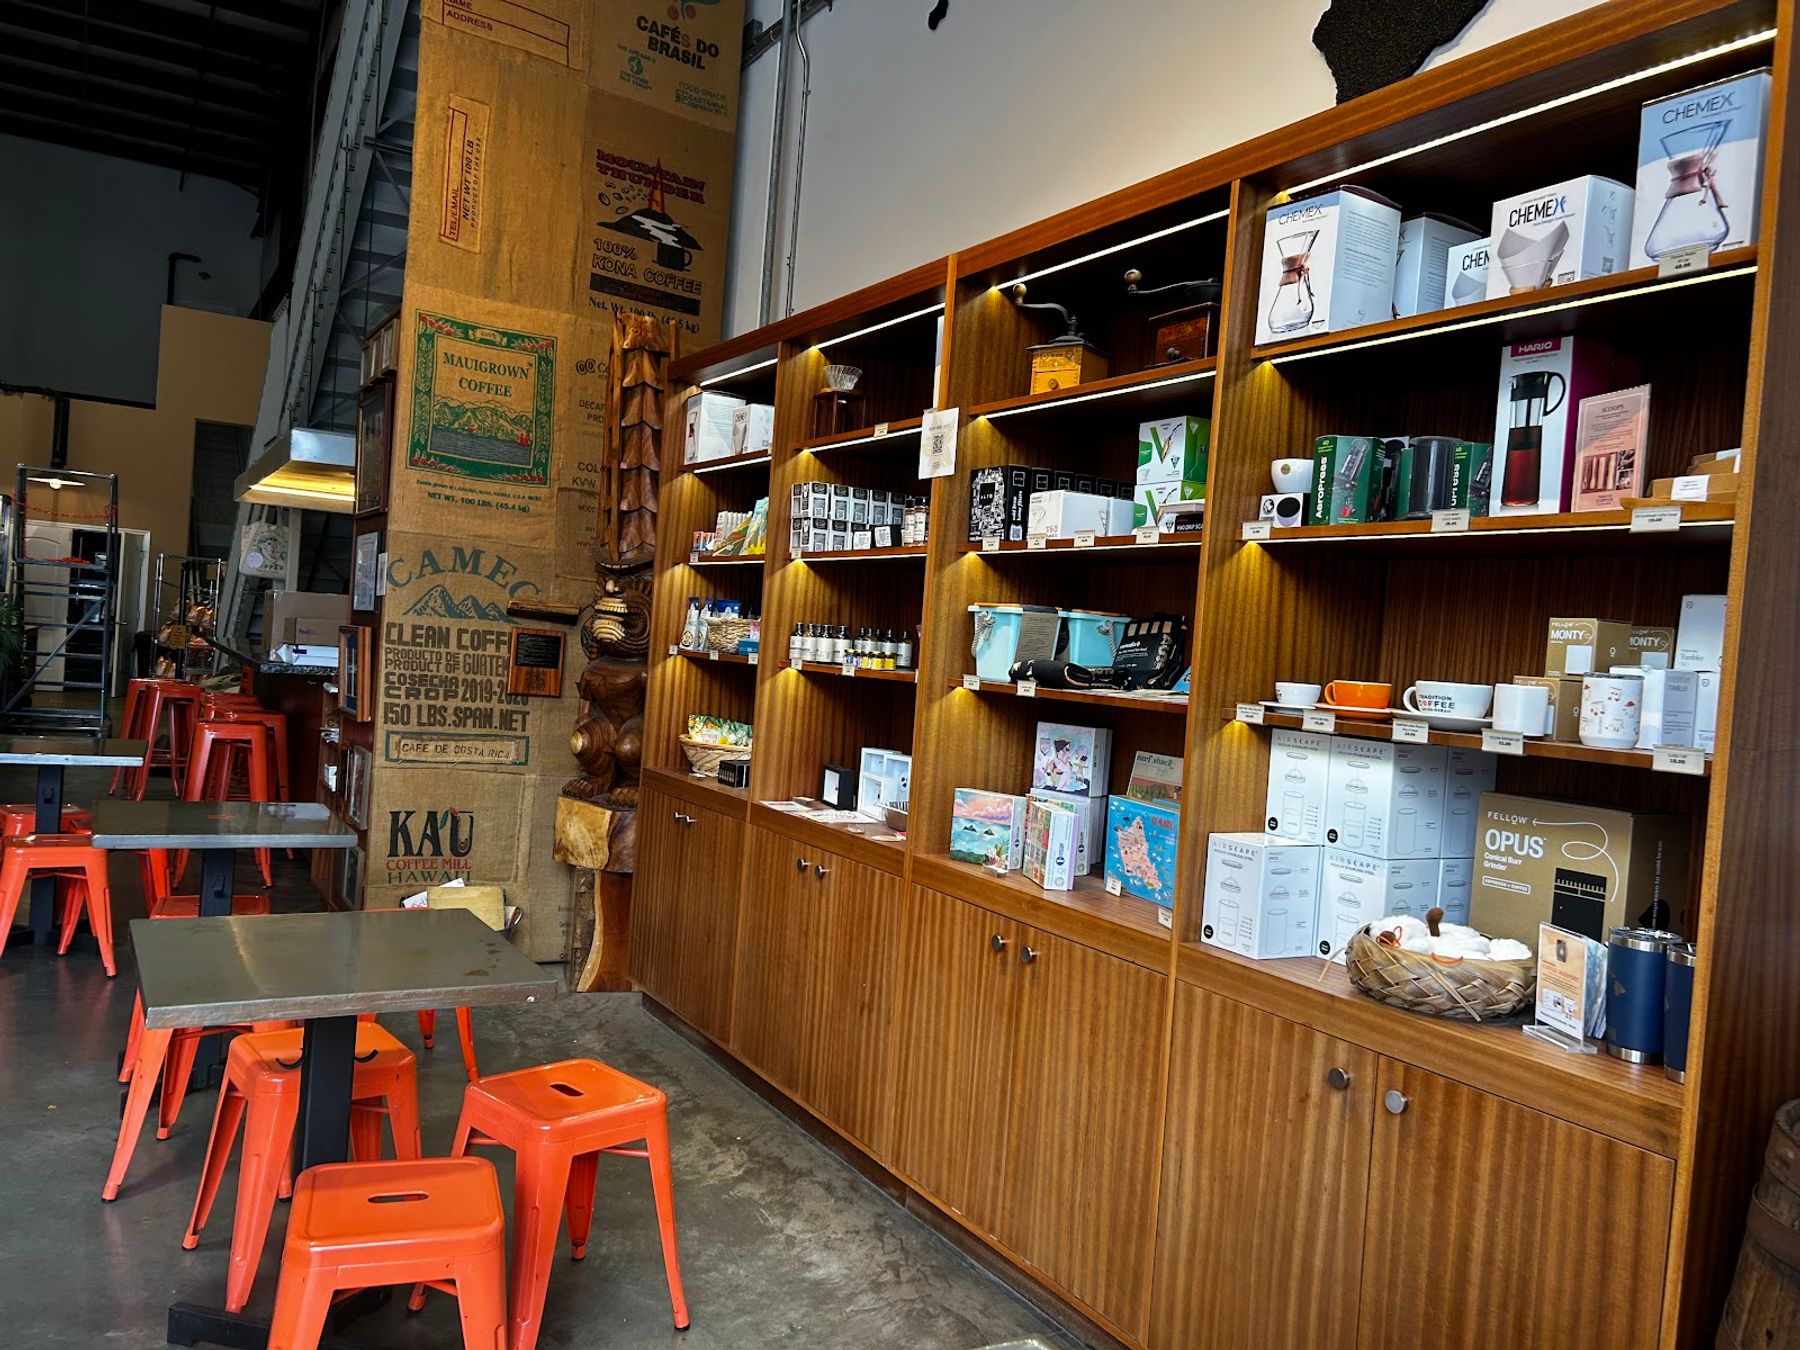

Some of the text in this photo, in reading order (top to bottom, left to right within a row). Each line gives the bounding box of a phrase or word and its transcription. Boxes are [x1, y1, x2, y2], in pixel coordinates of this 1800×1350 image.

[446, 10, 494, 31] ADDRESS
[635, 15, 720, 58] CAFÉS DO
[648, 36, 706, 70] BRASIL
[1662, 92, 1735, 124] CHEMEX
[462, 198, 470, 220] NET
[1278, 204, 1323, 226] CHEMEX
[1509, 196, 1566, 228] CHEMEX
[593, 236, 638, 260] 100%
[591, 254, 637, 279] KONA
[643, 267, 704, 295] COFFEE
[1518, 341, 1553, 353] HARIO
[442, 352, 530, 380] MAUIGROWN
[458, 377, 512, 398] COFFEE
[1315, 456, 1328, 519] AeroPress
[427, 492, 442, 500] NET
[461, 497, 475, 505] 100
[384, 621, 450, 649] CLEAN
[1551, 629, 1586, 640] MONTY
[384, 646, 461, 663] PRODUCTO DE
[384, 658, 442, 672] PRODUCT
[444, 661, 461, 674] OF
[383, 671, 460, 689] COSECHA
[383, 685, 460, 702] CROP
[383, 703, 411, 726] 150
[401, 743, 429, 753] CAFE
[434, 744, 449, 754] DE
[453, 744, 485, 756] COSTA
[1487, 811, 1528, 825] FELLOW
[1484, 828, 1544, 859] OPUS
[386, 859, 473, 871] COFFEE MILL
[1483, 860, 1507, 872] Grinder
[1484, 851, 1522, 865] Conical Burr
